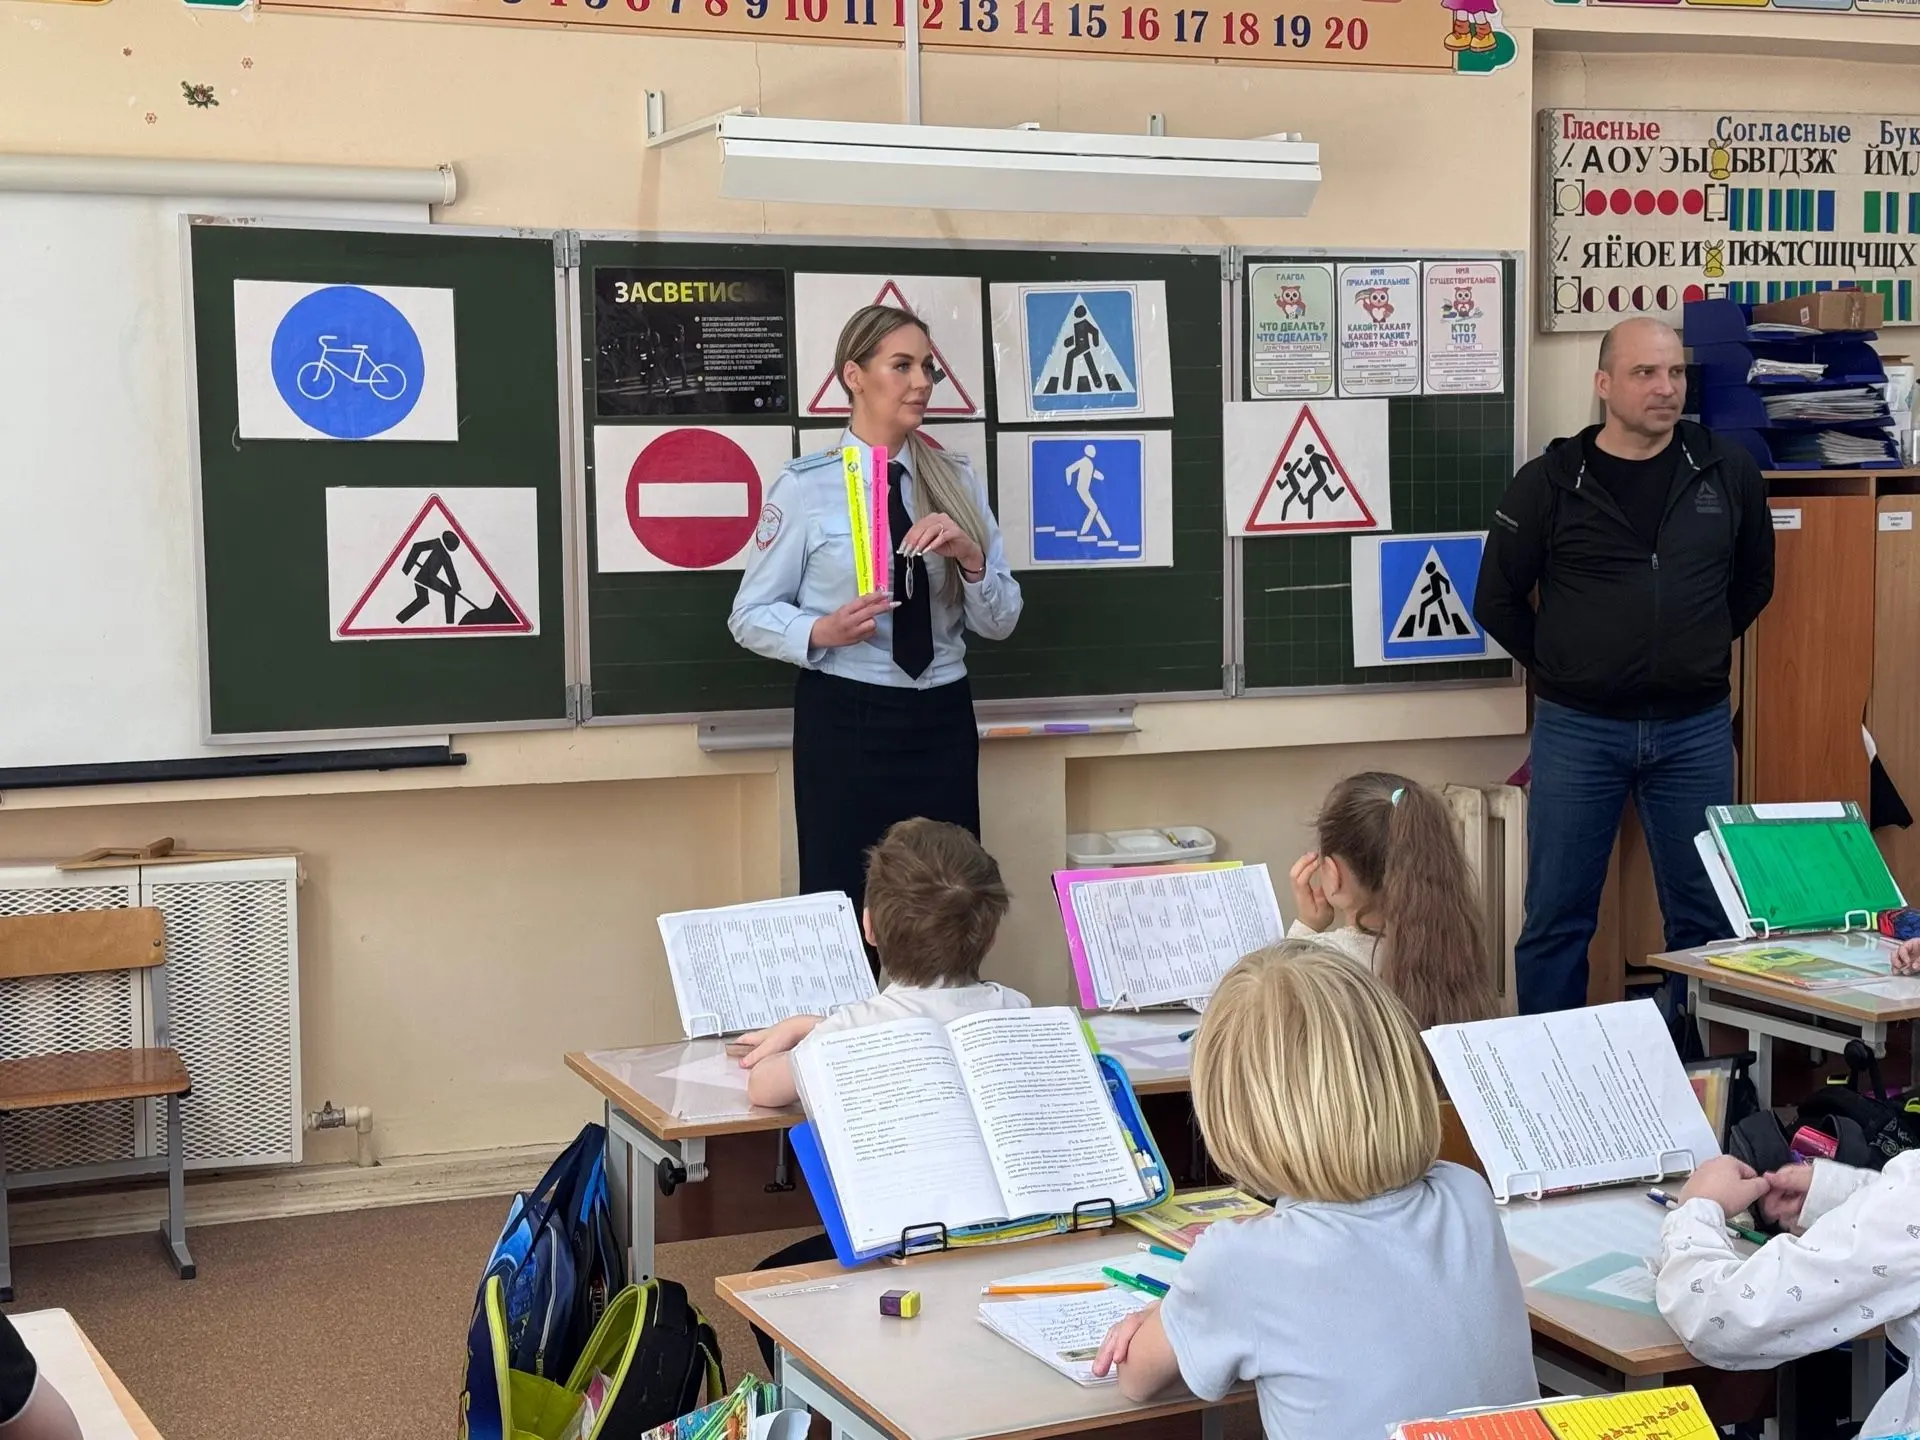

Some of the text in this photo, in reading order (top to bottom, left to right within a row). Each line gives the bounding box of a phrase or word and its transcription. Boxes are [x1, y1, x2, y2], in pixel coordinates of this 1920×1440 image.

[785, 0, 828, 23] 10
[844, 0, 877, 25] 11
[893, 0, 943, 30] 12
[959, 0, 999, 33] 13
[1014, 1, 1053, 35] 14
[1068, 3, 1107, 38] 15
[1121, 6, 1160, 41] 16
[1174, 9, 1209, 43] 17
[1222, 12, 1260, 46] 18
[1273, 14, 1311, 48] 19
[1325, 17, 1369, 51] 20
[1562, 113, 1661, 141] Гласные
[1716, 115, 1852, 144] Согласные
[1276, 273, 1306, 281] ГЛАГОЛ
[1430, 276, 1497, 285] СУЩЕСТВИТЕЛЬНОЕ
[1346, 278, 1410, 287] ПРИЛАГАТЕЛЬНОЕ
[1259, 322, 1325, 332] ЧТО ДЕЛАТЬ?
[1347, 323, 1411, 332] КАКОЙ? КАКАЯ?
[1451, 323, 1477, 333] КТО?
[1257, 332, 1329, 343] ЧТО СДЕЛАТЬ?
[1348, 332, 1411, 341] КАКОЕ? КАКИЕ?
[1451, 333, 1477, 343] ЧТО?
